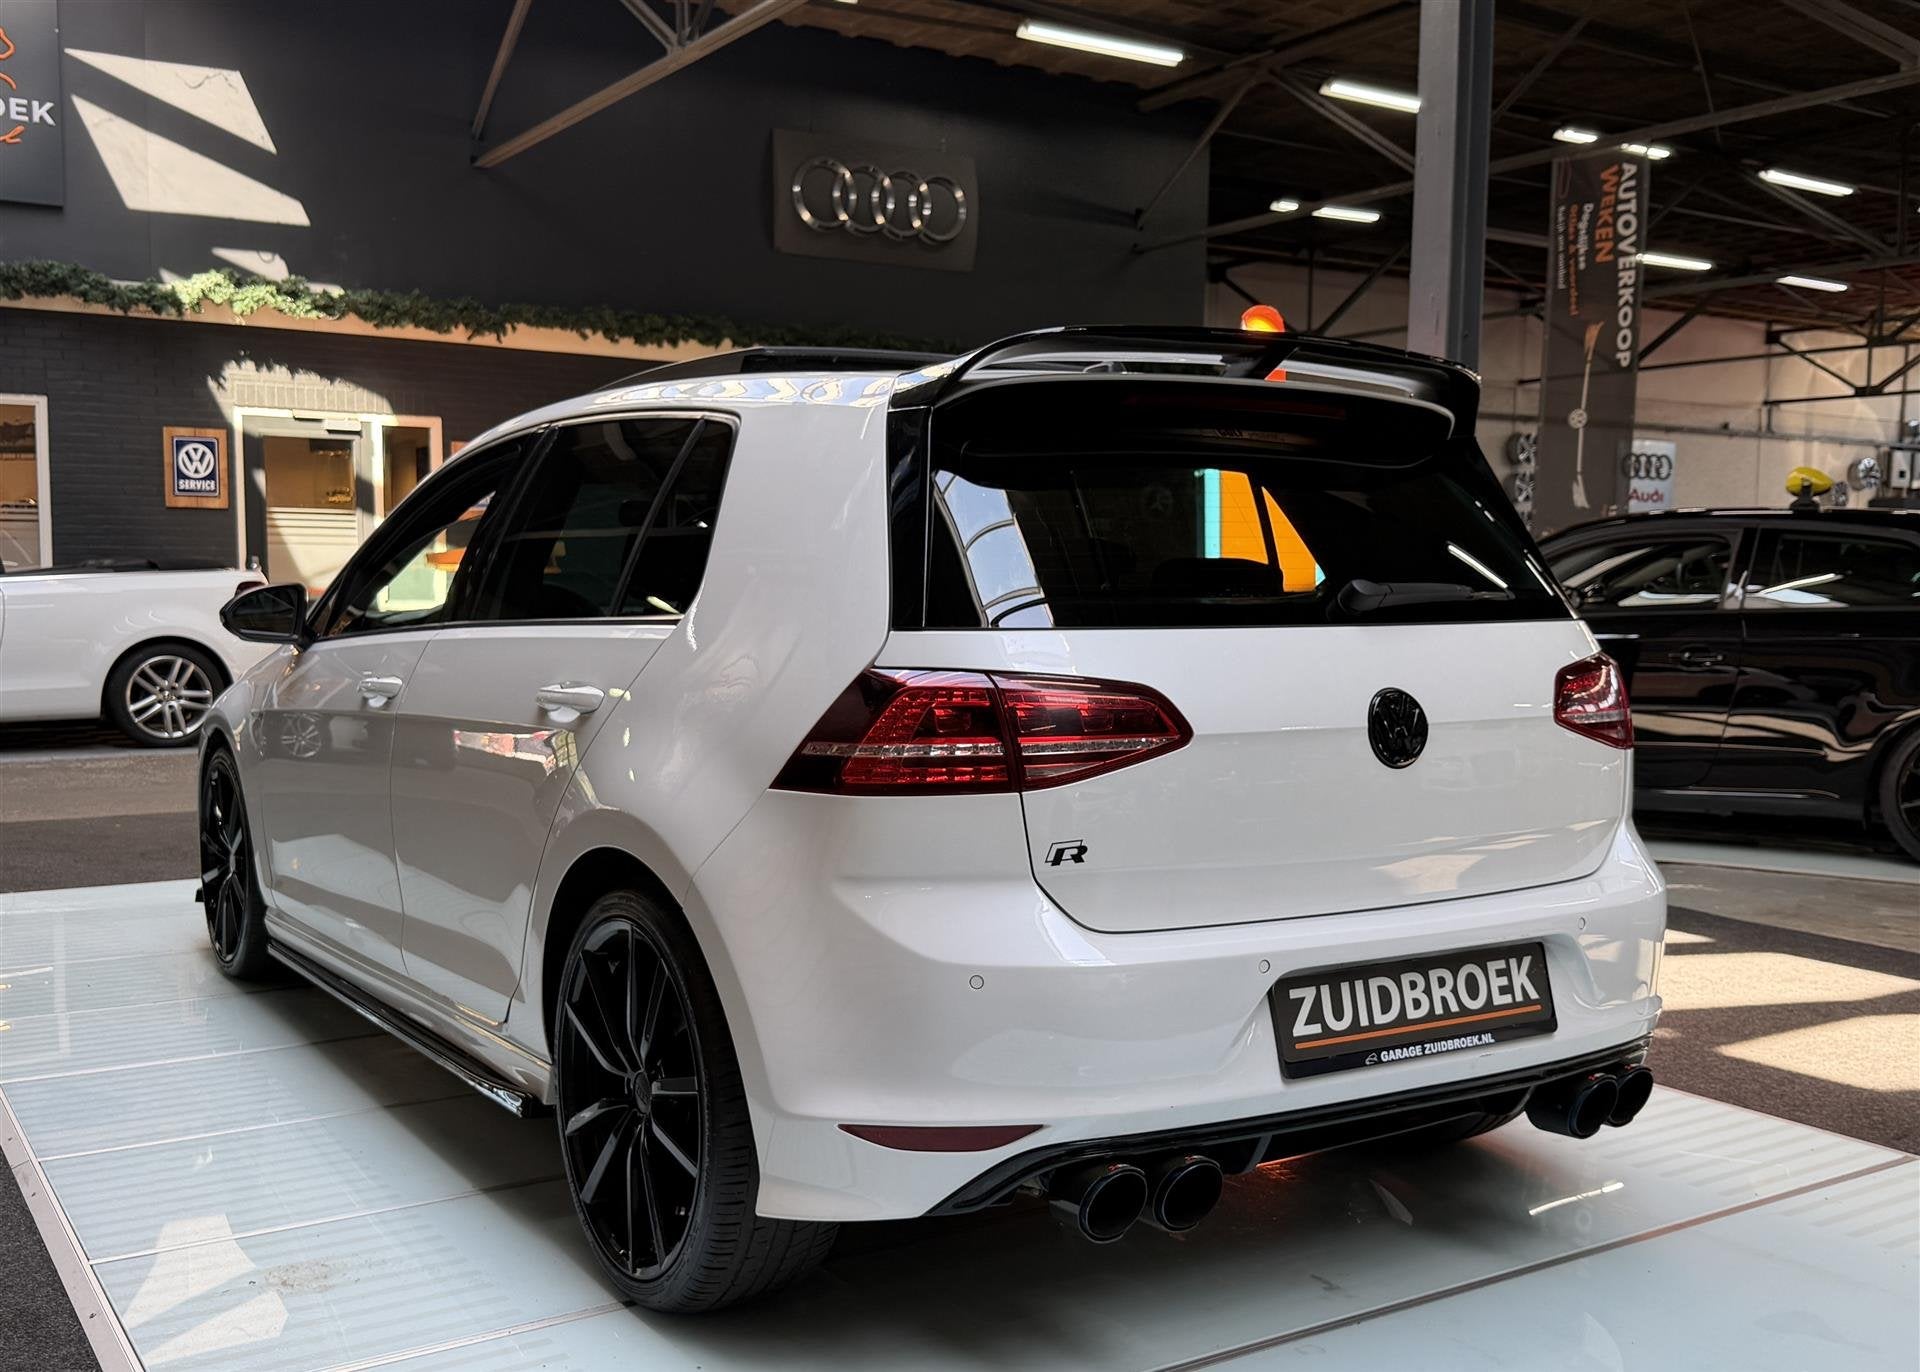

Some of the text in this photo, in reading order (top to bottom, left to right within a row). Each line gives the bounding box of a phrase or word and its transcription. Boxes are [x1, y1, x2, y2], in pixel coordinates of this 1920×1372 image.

[0, 97, 56, 126] EK
[1594, 164, 1620, 264] WEKEN
[1615, 162, 1638, 368] AUTOVERKOOP
[178, 479, 216, 491] SERVICE
[1627, 488, 1664, 503] Audi
[1289, 955, 1540, 1037] ZUIDBROEK
[1380, 1032, 1495, 1062] GARAGE ZUIDBROEK.NL
